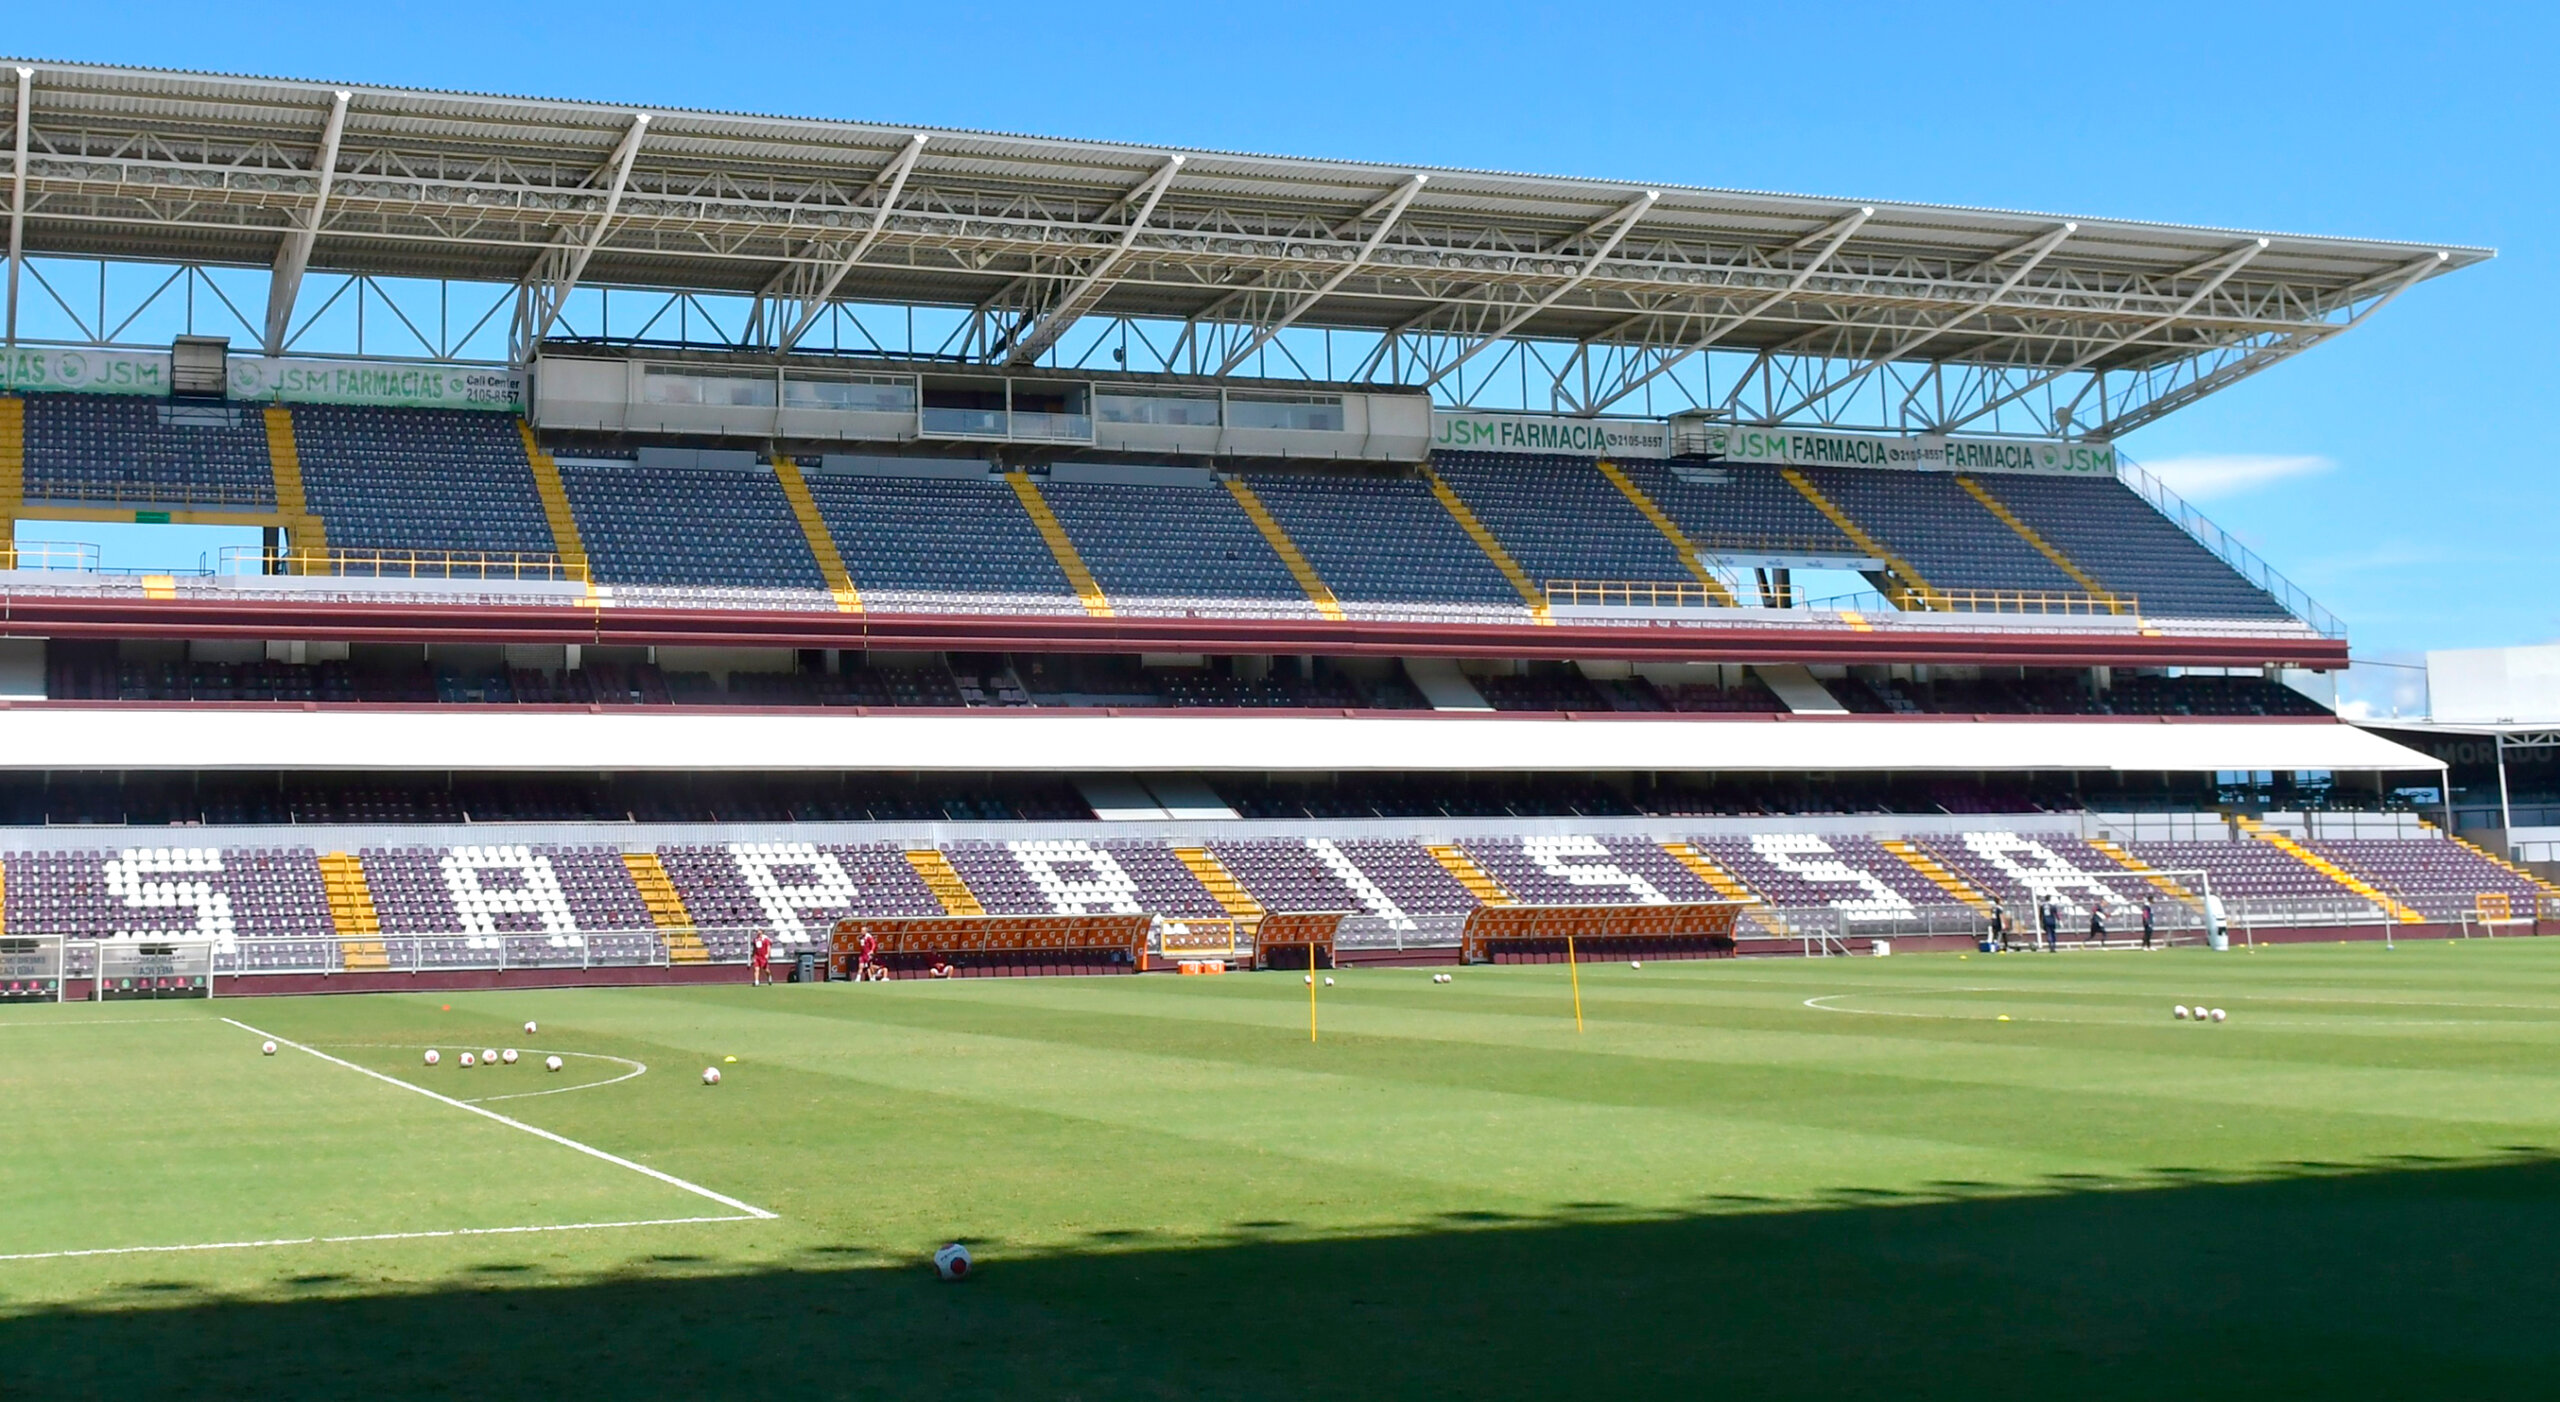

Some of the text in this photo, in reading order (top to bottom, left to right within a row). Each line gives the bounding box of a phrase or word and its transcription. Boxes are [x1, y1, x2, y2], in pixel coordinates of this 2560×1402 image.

[95, 361, 160, 386] JSM
[269, 368, 329, 392] JSM
[466, 375, 520, 389] Call Center
[466, 388, 520, 405] 2105-8557
[1438, 420, 1608, 450] JSM FARMACIA
[1617, 434, 1664, 448] 2105-8557
[1732, 433, 1888, 464] JSM FARMACIA
[1944, 442, 2035, 470] FARMACIA
[2062, 450, 2112, 472] JSM
